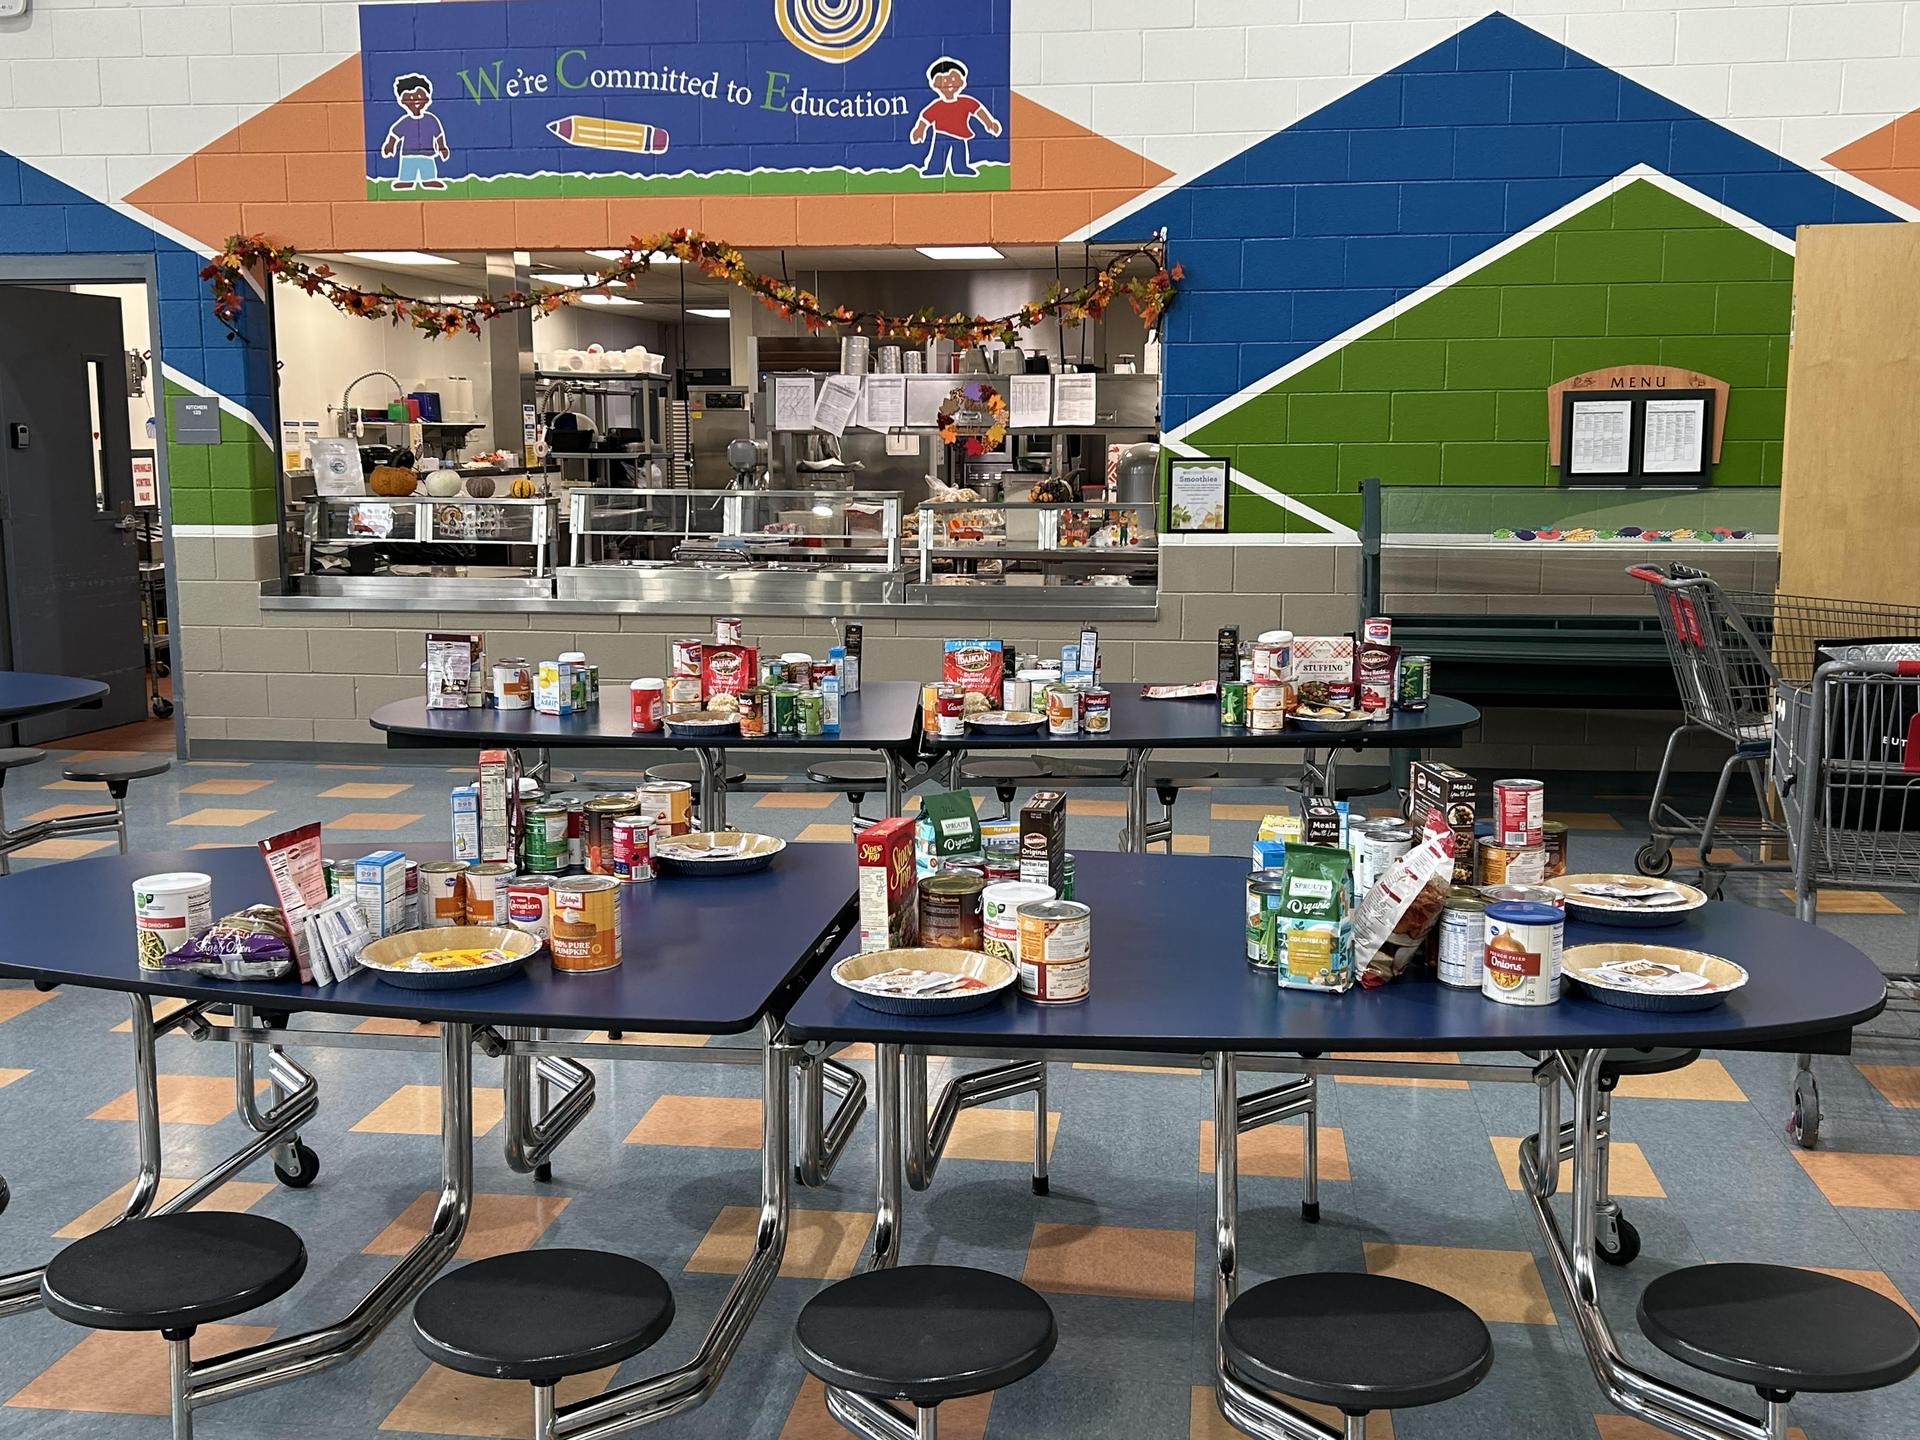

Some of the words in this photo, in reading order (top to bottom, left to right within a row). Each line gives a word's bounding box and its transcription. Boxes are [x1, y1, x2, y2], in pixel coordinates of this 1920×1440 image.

[456, 60, 548, 106] We're
[556, 49, 719, 99] Committed
[727, 80, 752, 106] to
[760, 70, 909, 118] Education
[1610, 376, 1667, 388] MENU
[1178, 475, 1218, 483] Smoothies
[957, 653, 990, 665] IDAHOAN
[1302, 664, 1343, 672] STUFFING
[1452, 783, 1473, 791] Meals
[1312, 821, 1337, 829] Meals
[943, 835, 975, 850] Organic
[859, 843, 884, 860] Stove
[1021, 848, 1048, 857] Original
[867, 853, 881, 863] Top
[1294, 882, 1329, 891] SPROUTS
[510, 898, 541, 911] Carnation
[1286, 898, 1331, 914] Organic
[568, 941, 591, 949] PURE
[1288, 936, 1329, 945] COLOMBIAN
[194, 940, 219, 956] Sage
[554, 947, 589, 955] PUMPKIN
[1491, 956, 1522, 972] Onions
